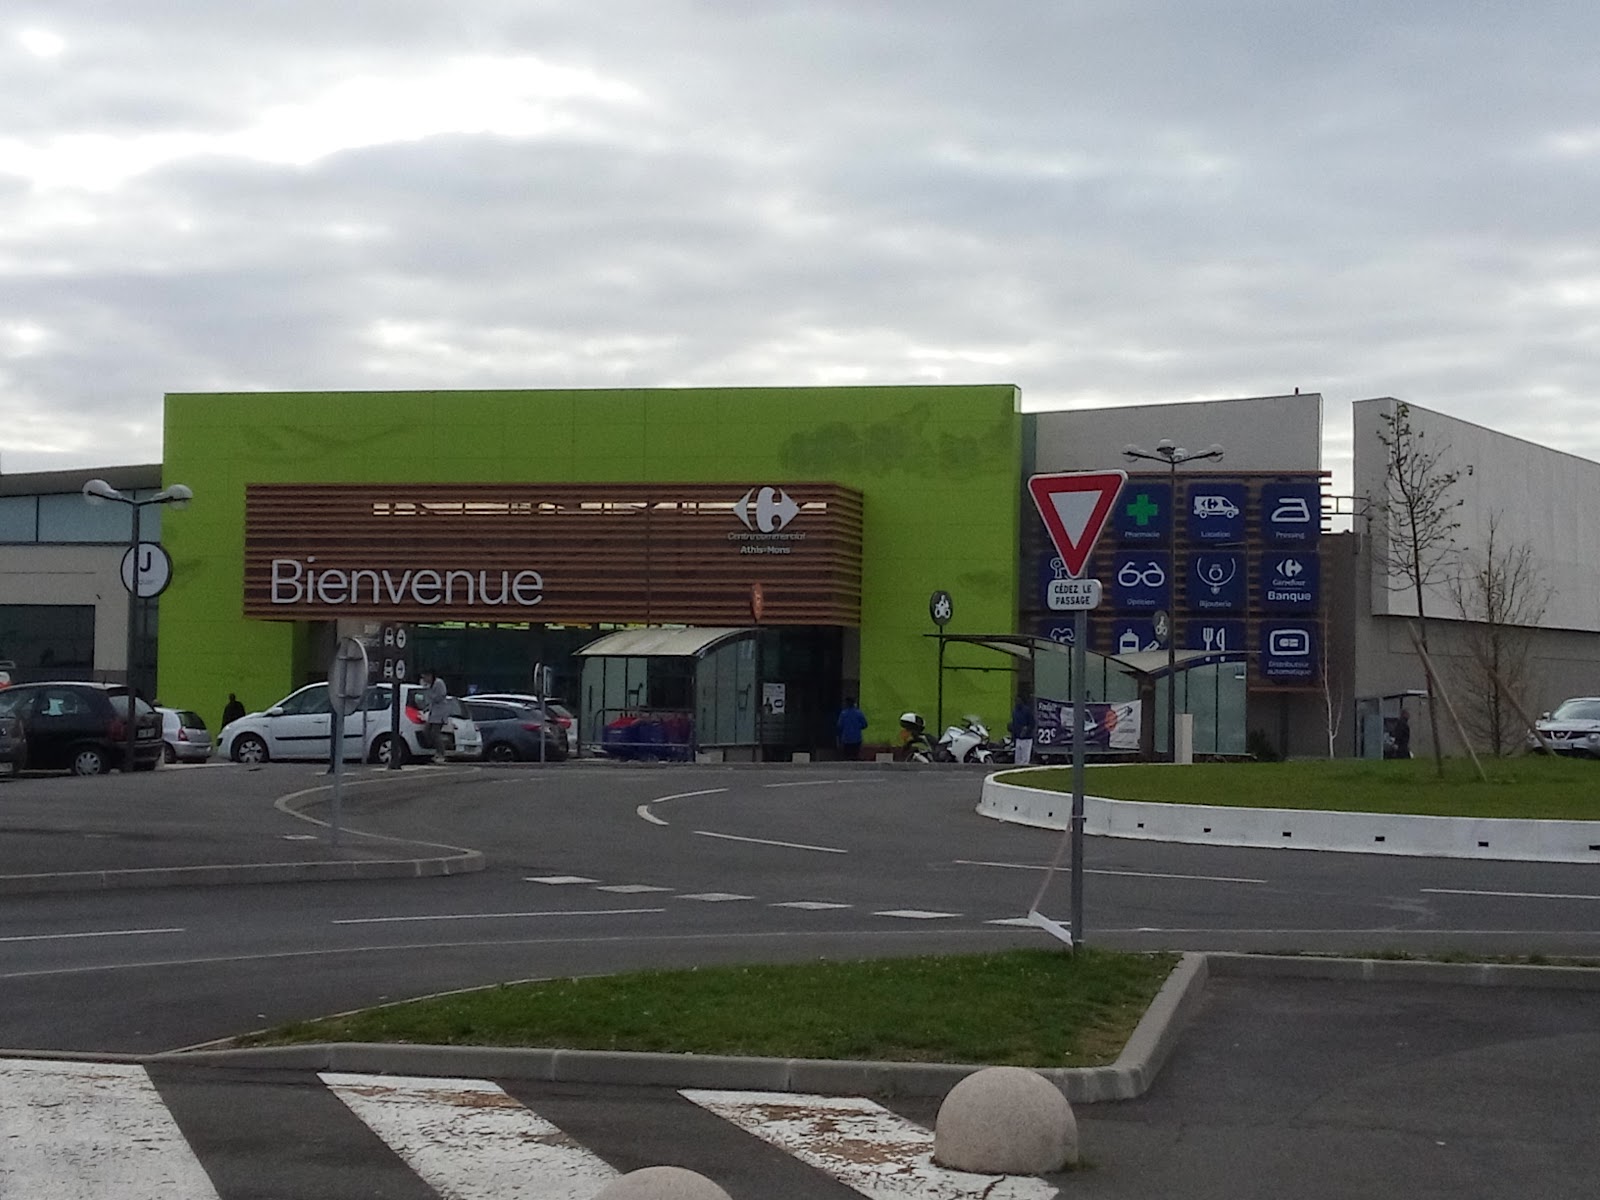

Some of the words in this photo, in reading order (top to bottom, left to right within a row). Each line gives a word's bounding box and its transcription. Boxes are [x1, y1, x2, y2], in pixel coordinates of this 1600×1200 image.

[1275, 531, 1305, 539] Pressing
[740, 546, 791, 554] Athis-Mons
[140, 551, 152, 573] J
[271, 555, 543, 605] Bienvenue
[1054, 583, 1079, 594] CÉDEZ
[1083, 584, 1092, 594] LE
[1055, 596, 1090, 605] PASSAGE
[1267, 590, 1312, 603] Banque
